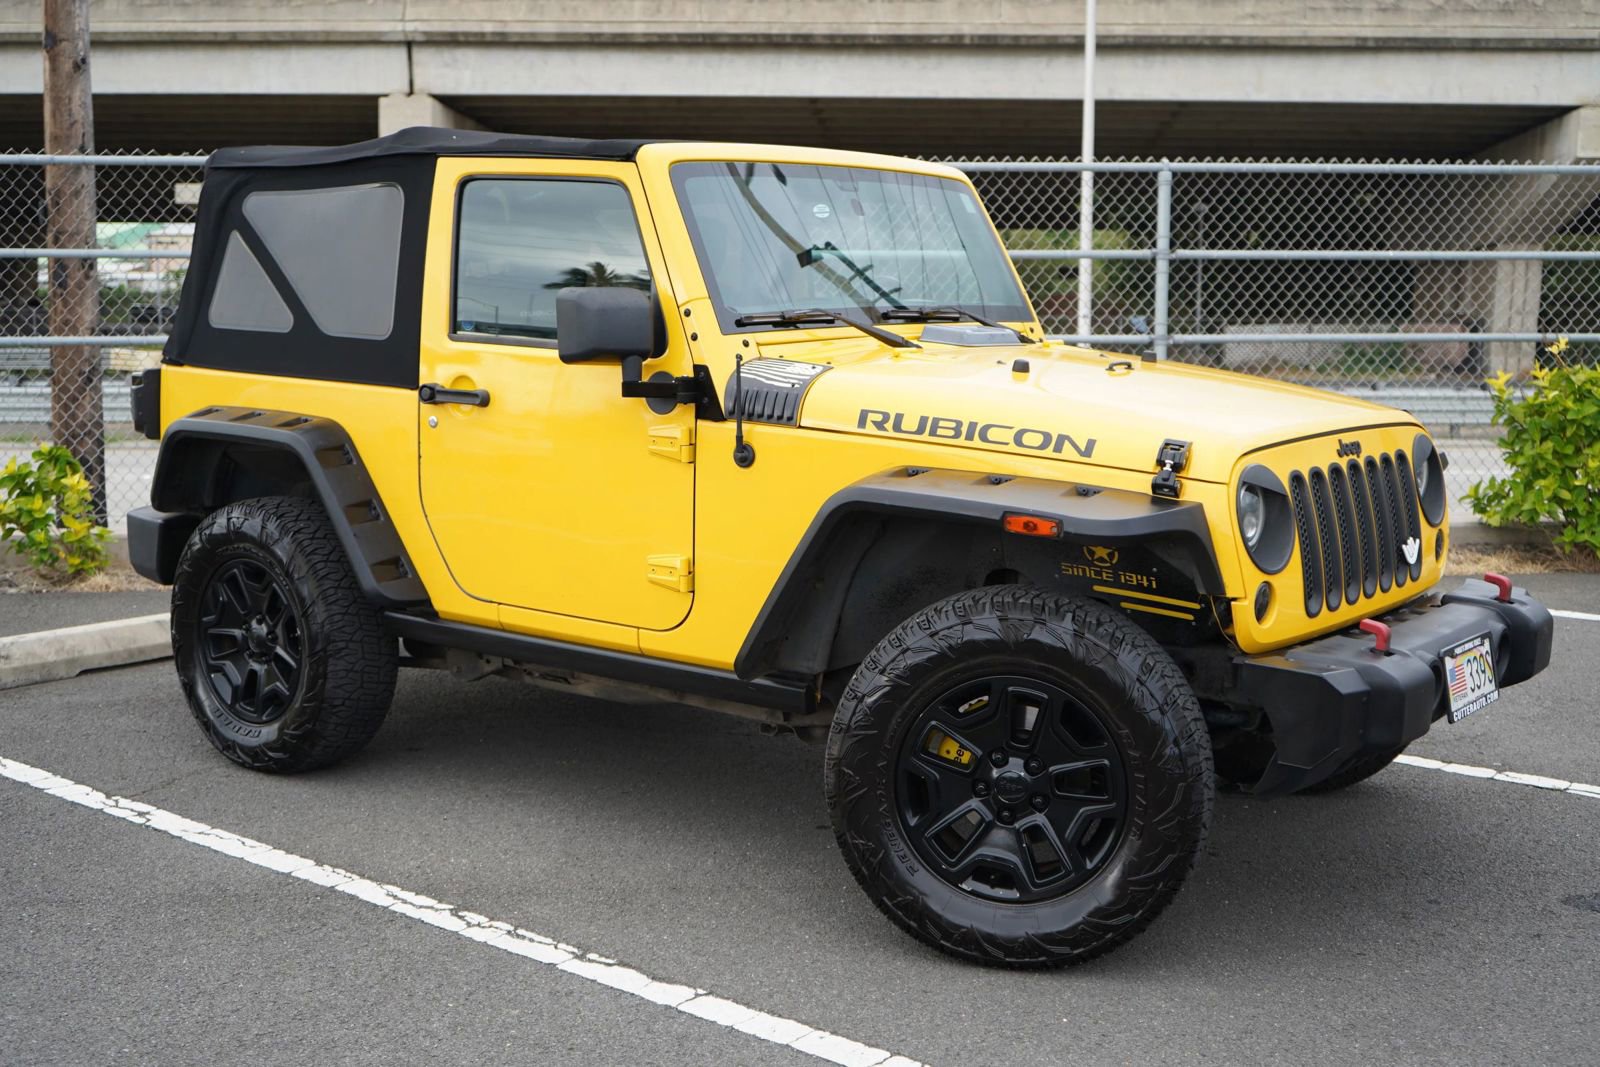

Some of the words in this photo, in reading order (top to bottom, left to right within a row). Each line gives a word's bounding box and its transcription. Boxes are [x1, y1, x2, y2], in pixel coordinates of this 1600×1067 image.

[857, 408, 1097, 459] RUBICON
[1336, 438, 1362, 458] Jeep
[1118, 571, 1157, 589] 1941
[1453, 690, 1499, 722] CUTTERAUTO.COM
